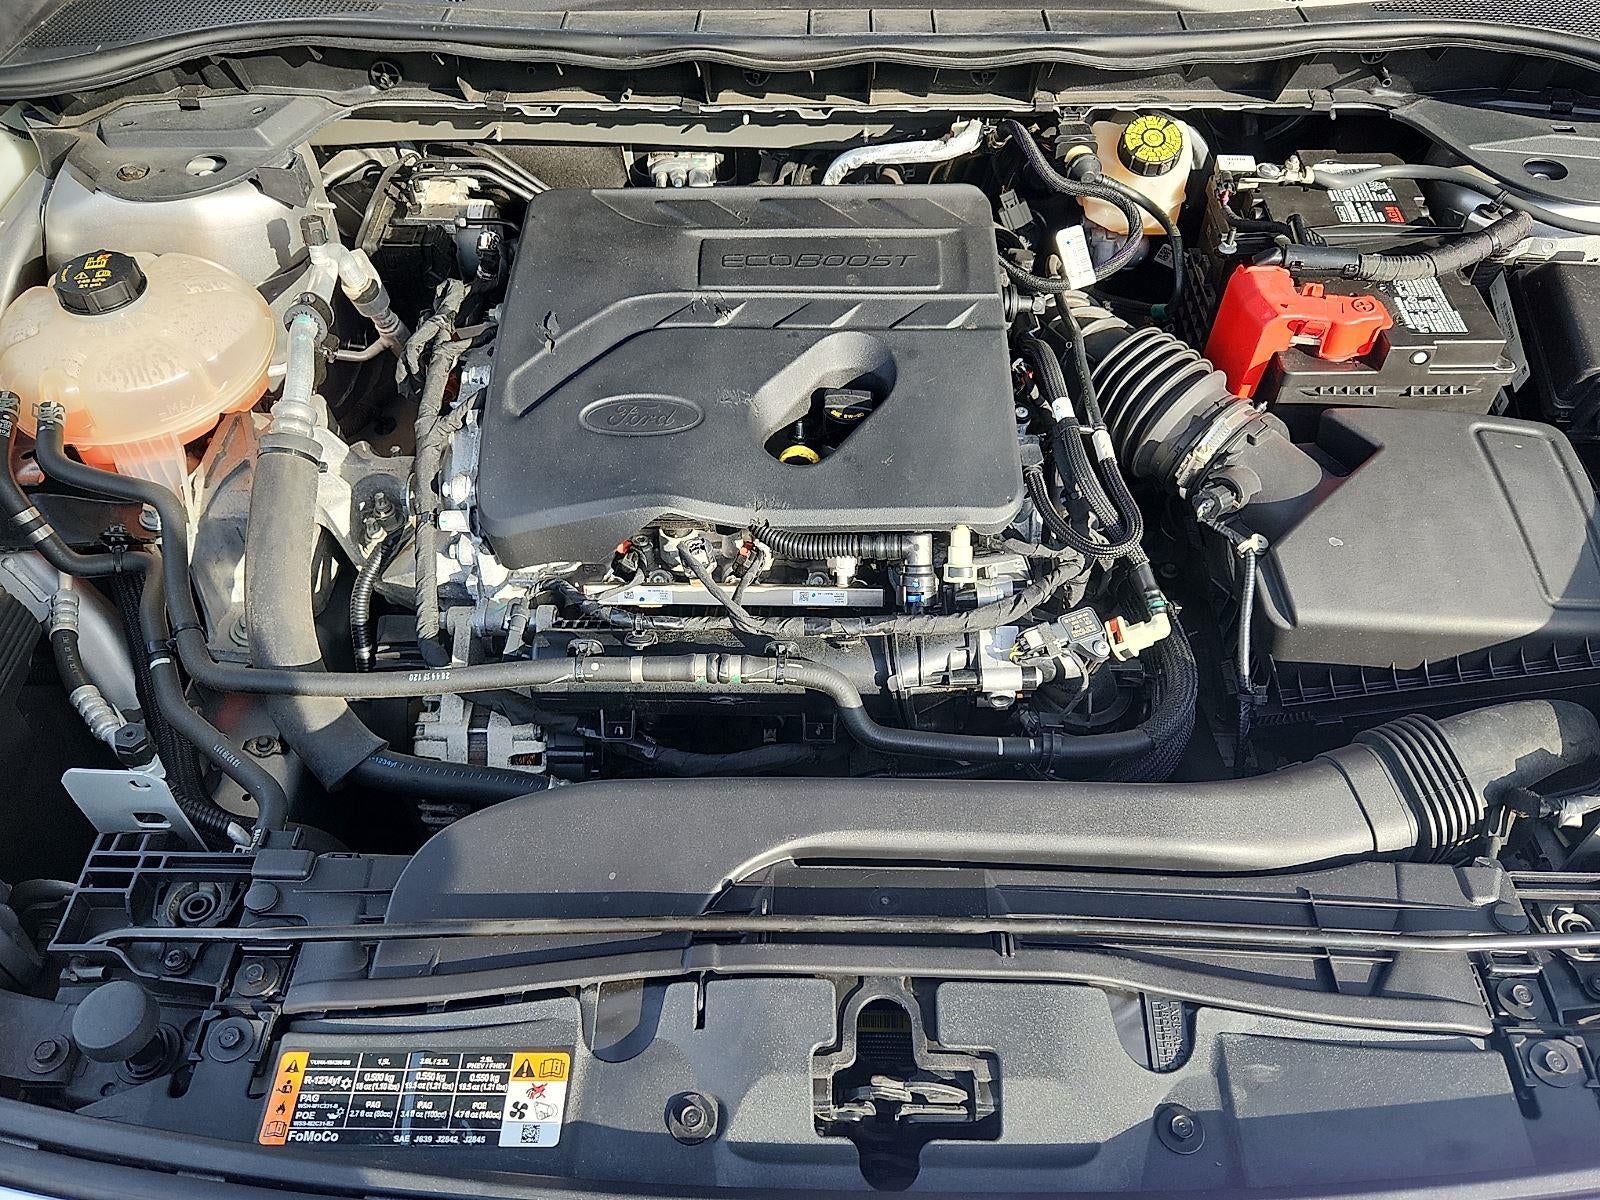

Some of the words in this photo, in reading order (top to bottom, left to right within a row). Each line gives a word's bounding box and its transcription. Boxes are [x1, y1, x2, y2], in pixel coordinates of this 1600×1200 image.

[721, 253, 917, 269] ECOBOOST
[607, 405, 679, 427] Ford
[304, 1075, 342, 1086] R-1234yf
[384, 1073, 395, 1084] kg
[436, 1072, 446, 1083] kg
[490, 1073, 500, 1084] kg
[300, 1094, 320, 1103] PAG
[365, 1101, 381, 1109] PAG
[295, 1111, 316, 1120] POE
[287, 1130, 339, 1142] FoMoCo
[393, 1135, 410, 1143] SAE
[413, 1135, 433, 1143] J639
[435, 1135, 459, 1143] J2842
[463, 1135, 486, 1143] J2845
